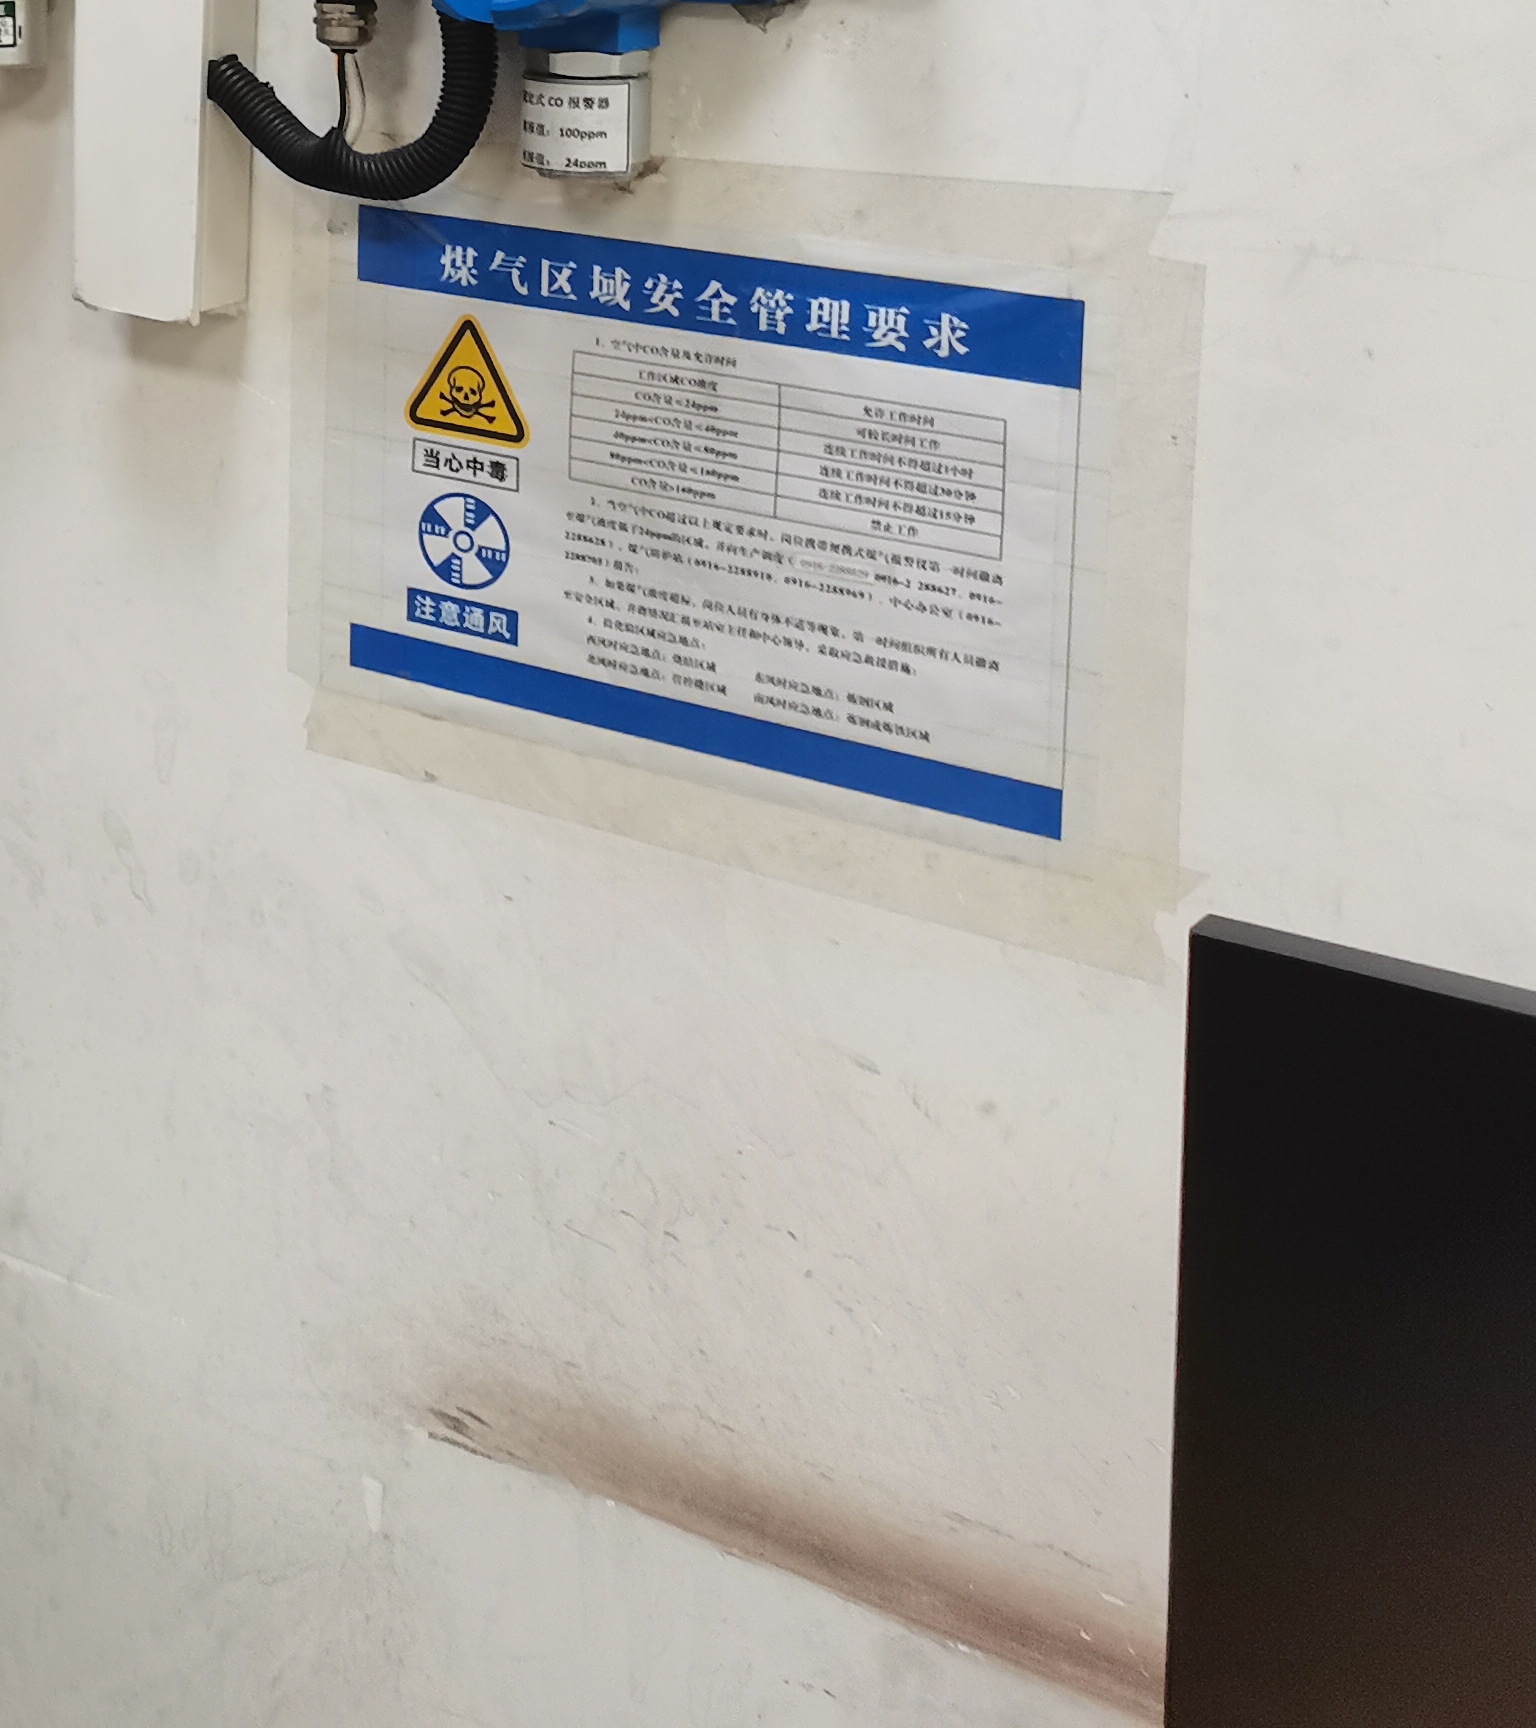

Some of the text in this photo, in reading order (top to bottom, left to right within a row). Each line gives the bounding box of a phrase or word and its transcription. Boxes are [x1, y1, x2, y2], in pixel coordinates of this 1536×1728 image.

[559, 127, 607, 141] 100ppm
[439, 244, 970, 358] 煤气区域安全管理要求
[422, 447, 508, 483] 当心中毒
[414, 594, 510, 639] 注意通风
